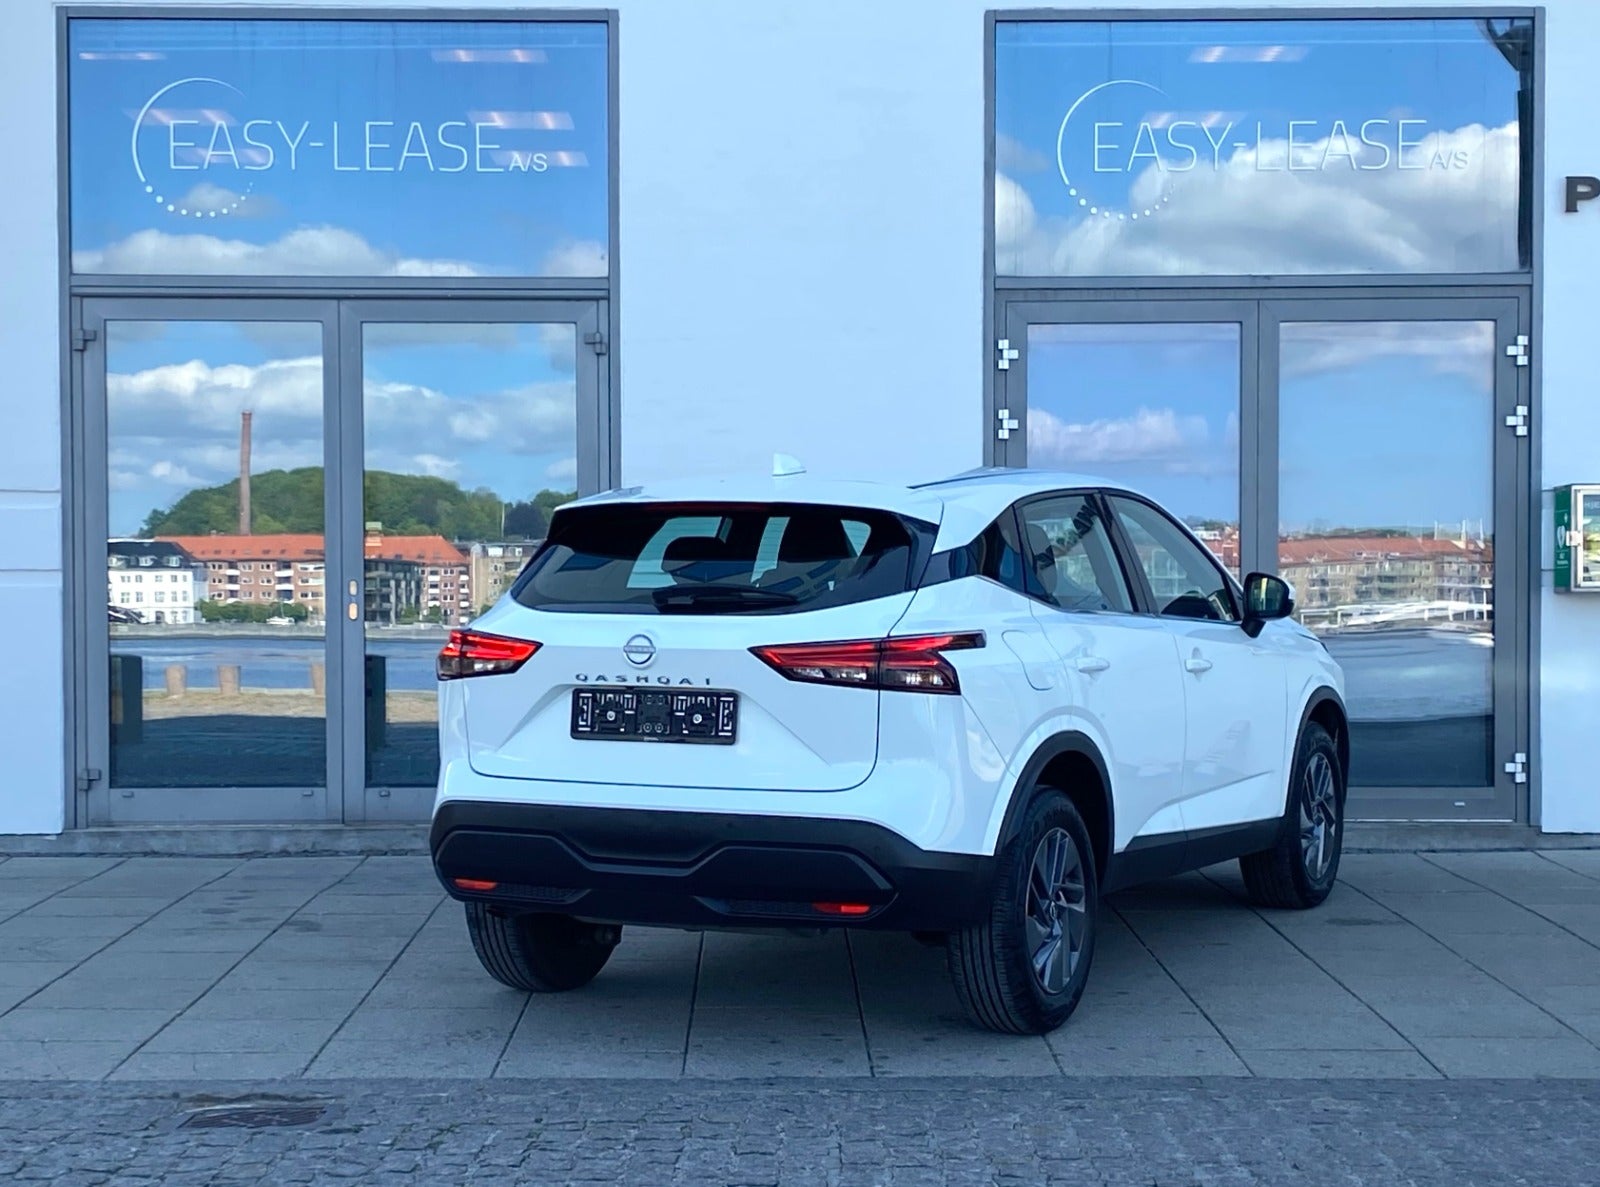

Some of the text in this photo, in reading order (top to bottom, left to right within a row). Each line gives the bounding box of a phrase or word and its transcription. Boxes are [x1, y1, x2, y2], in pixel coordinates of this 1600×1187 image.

[168, 119, 549, 173] EASY-LEASE A/S
[1092, 118, 1470, 173] EASY-LEASE A/S
[574, 672, 711, 686] QASHQAI
